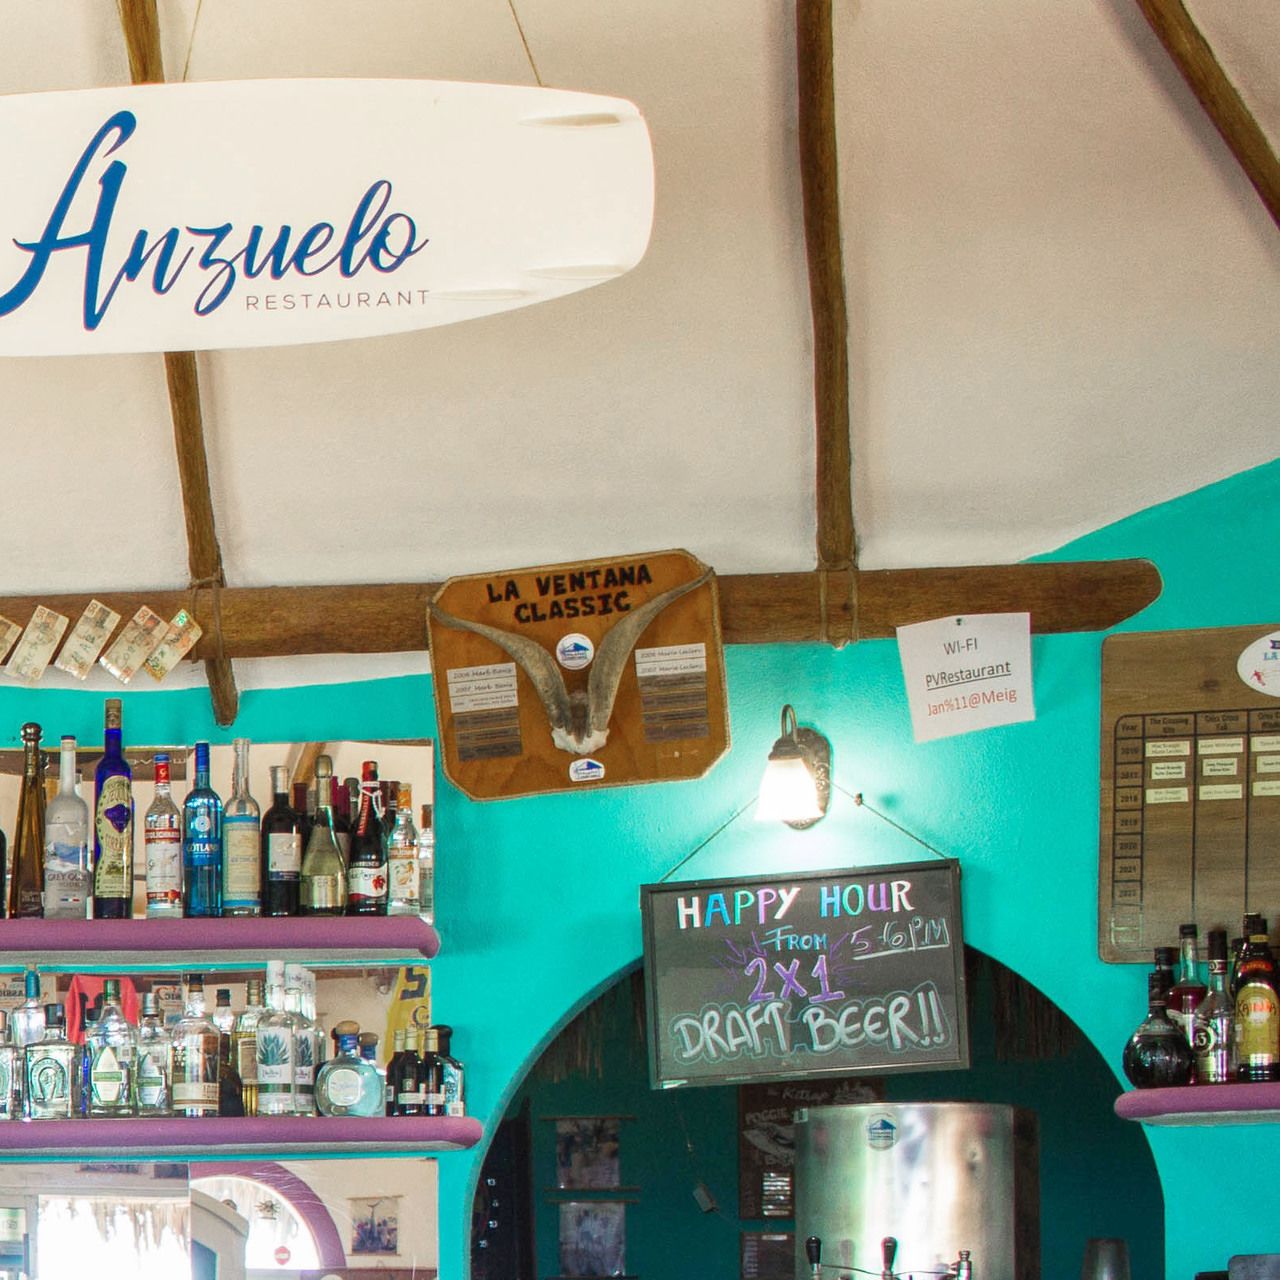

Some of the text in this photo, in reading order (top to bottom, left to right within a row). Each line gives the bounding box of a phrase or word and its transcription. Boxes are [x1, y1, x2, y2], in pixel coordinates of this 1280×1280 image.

[246, 290, 431, 312] RESTAURANT
[486, 564, 653, 603] LA VENTANA
[513, 591, 631, 624] CLASSIC
[943, 637, 978, 655] WI-FI
[925, 662, 1011, 687] PVRestaurant
[677, 881, 914, 929] HAPPY HOUR
[761, 925, 828, 951] FROM
[674, 990, 944, 1058] DRAFT BEER!!
